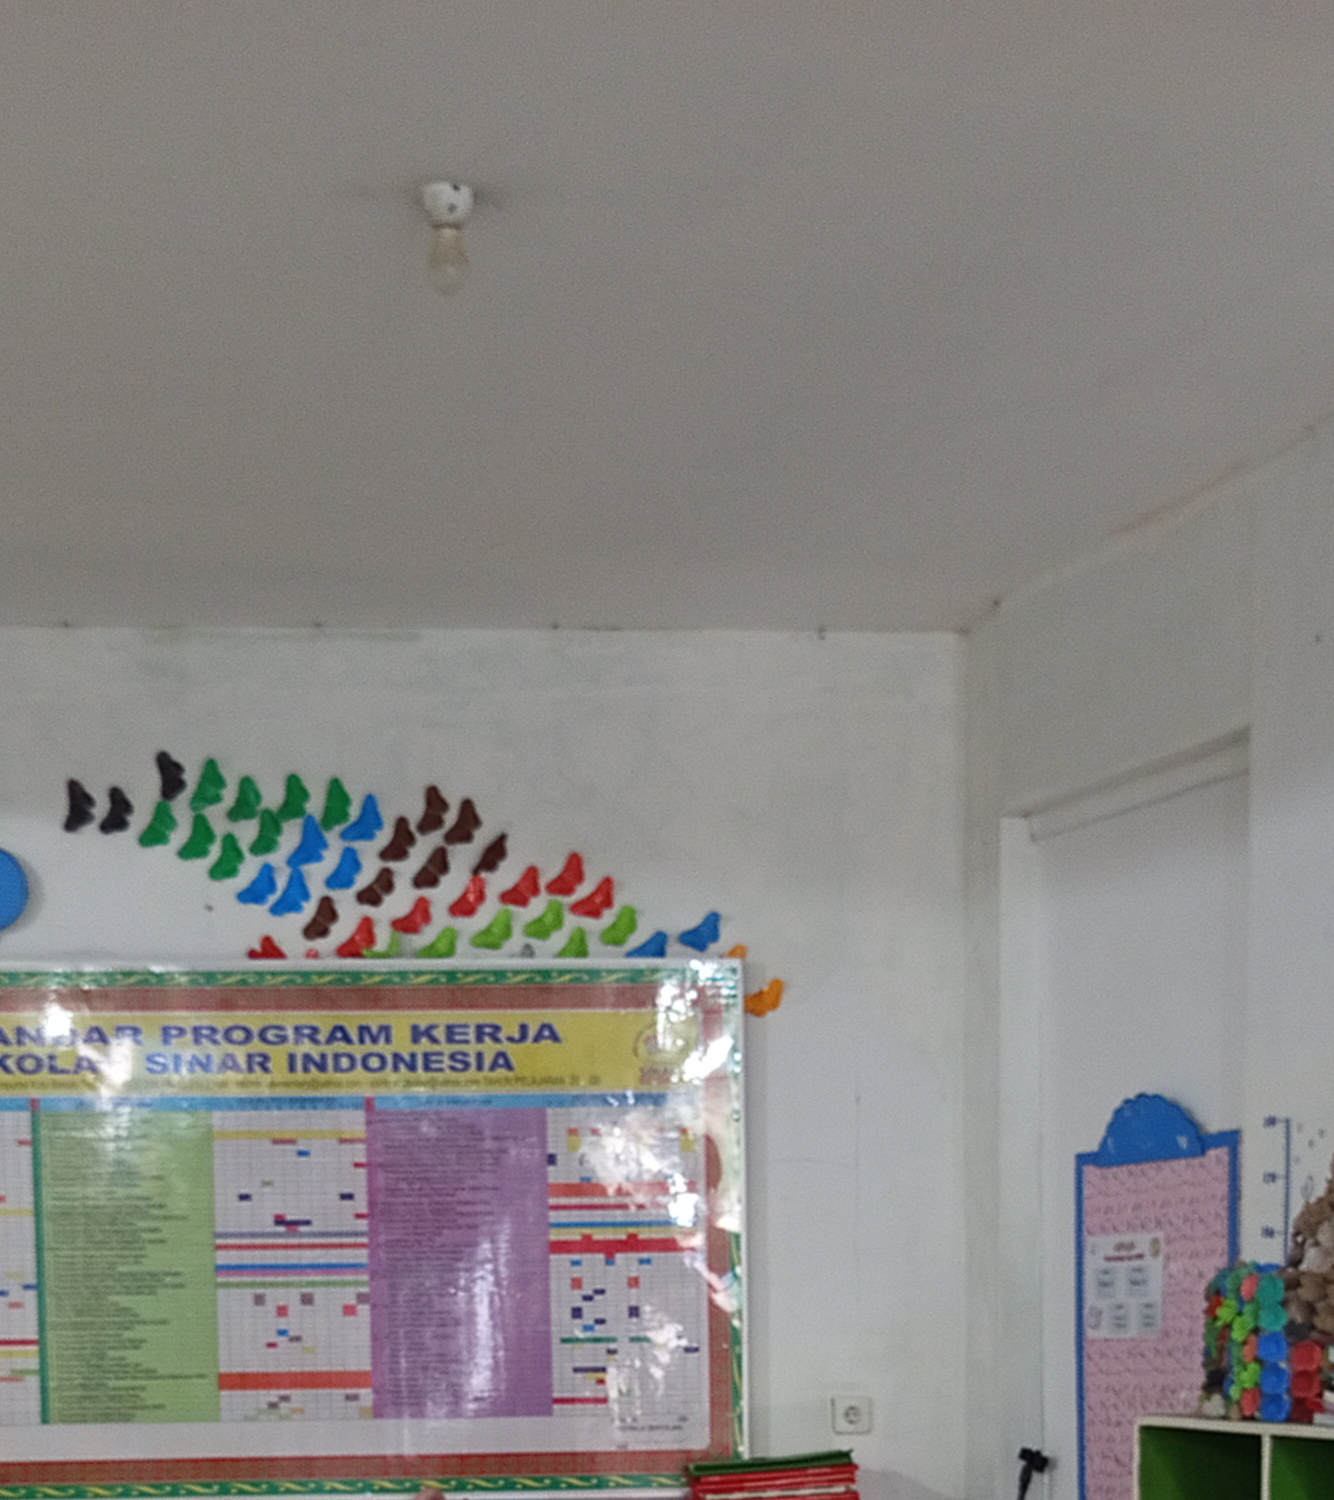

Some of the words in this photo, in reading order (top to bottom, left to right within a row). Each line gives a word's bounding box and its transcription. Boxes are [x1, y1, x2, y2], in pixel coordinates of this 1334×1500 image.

[162, 1023, 393, 1046] PROGRAM
[411, 1022, 562, 1044] KERJA
[146, 1051, 271, 1074] SINAR
[288, 1050, 515, 1073] INDONESIA
